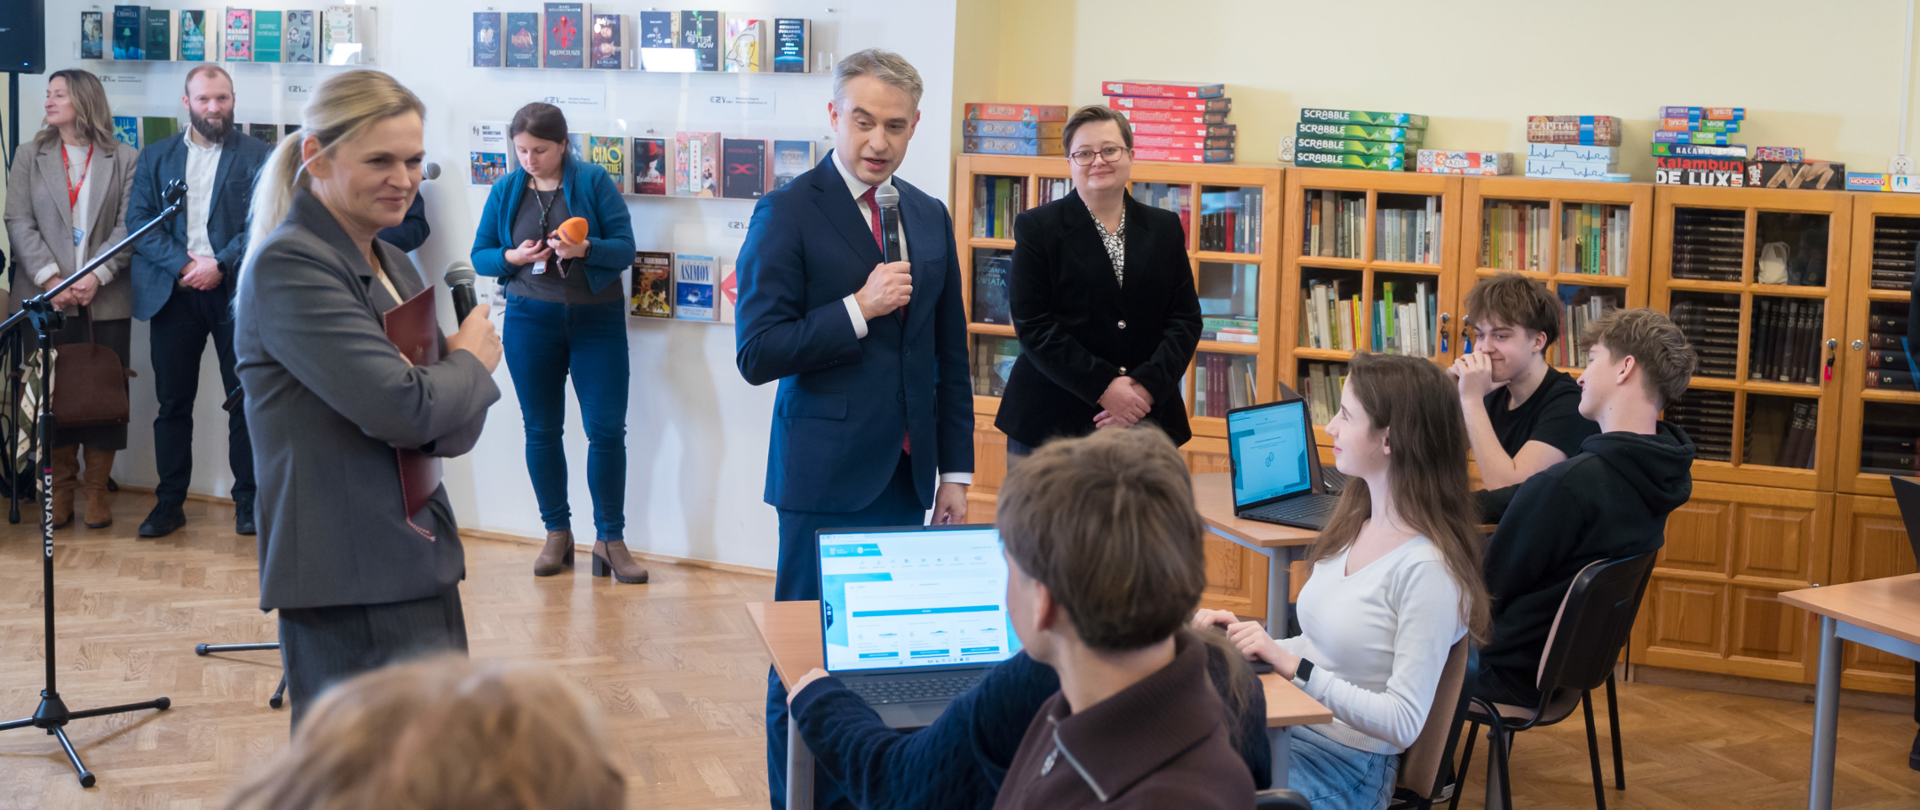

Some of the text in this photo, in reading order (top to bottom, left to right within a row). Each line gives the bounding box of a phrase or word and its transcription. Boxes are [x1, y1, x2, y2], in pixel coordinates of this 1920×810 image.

[687, 36, 713, 44] BETTER
[1304, 109, 1350, 121] SCRABBLE
[1299, 123, 1346, 135] SCRABBLE
[1531, 121, 1577, 131] CAPITAL
[1298, 138, 1345, 150] SCRABBLE
[593, 146, 622, 164] CIAO
[1297, 152, 1344, 164] SCRABBLE
[1657, 157, 1744, 174] Kalambury
[1656, 171, 1682, 185] DE
[1689, 172, 1743, 187] LUXE
[1850, 178, 1885, 186] MONOPOLY
[680, 264, 710, 282] ASIMOV
[45, 474, 54, 558] DYNAWID
